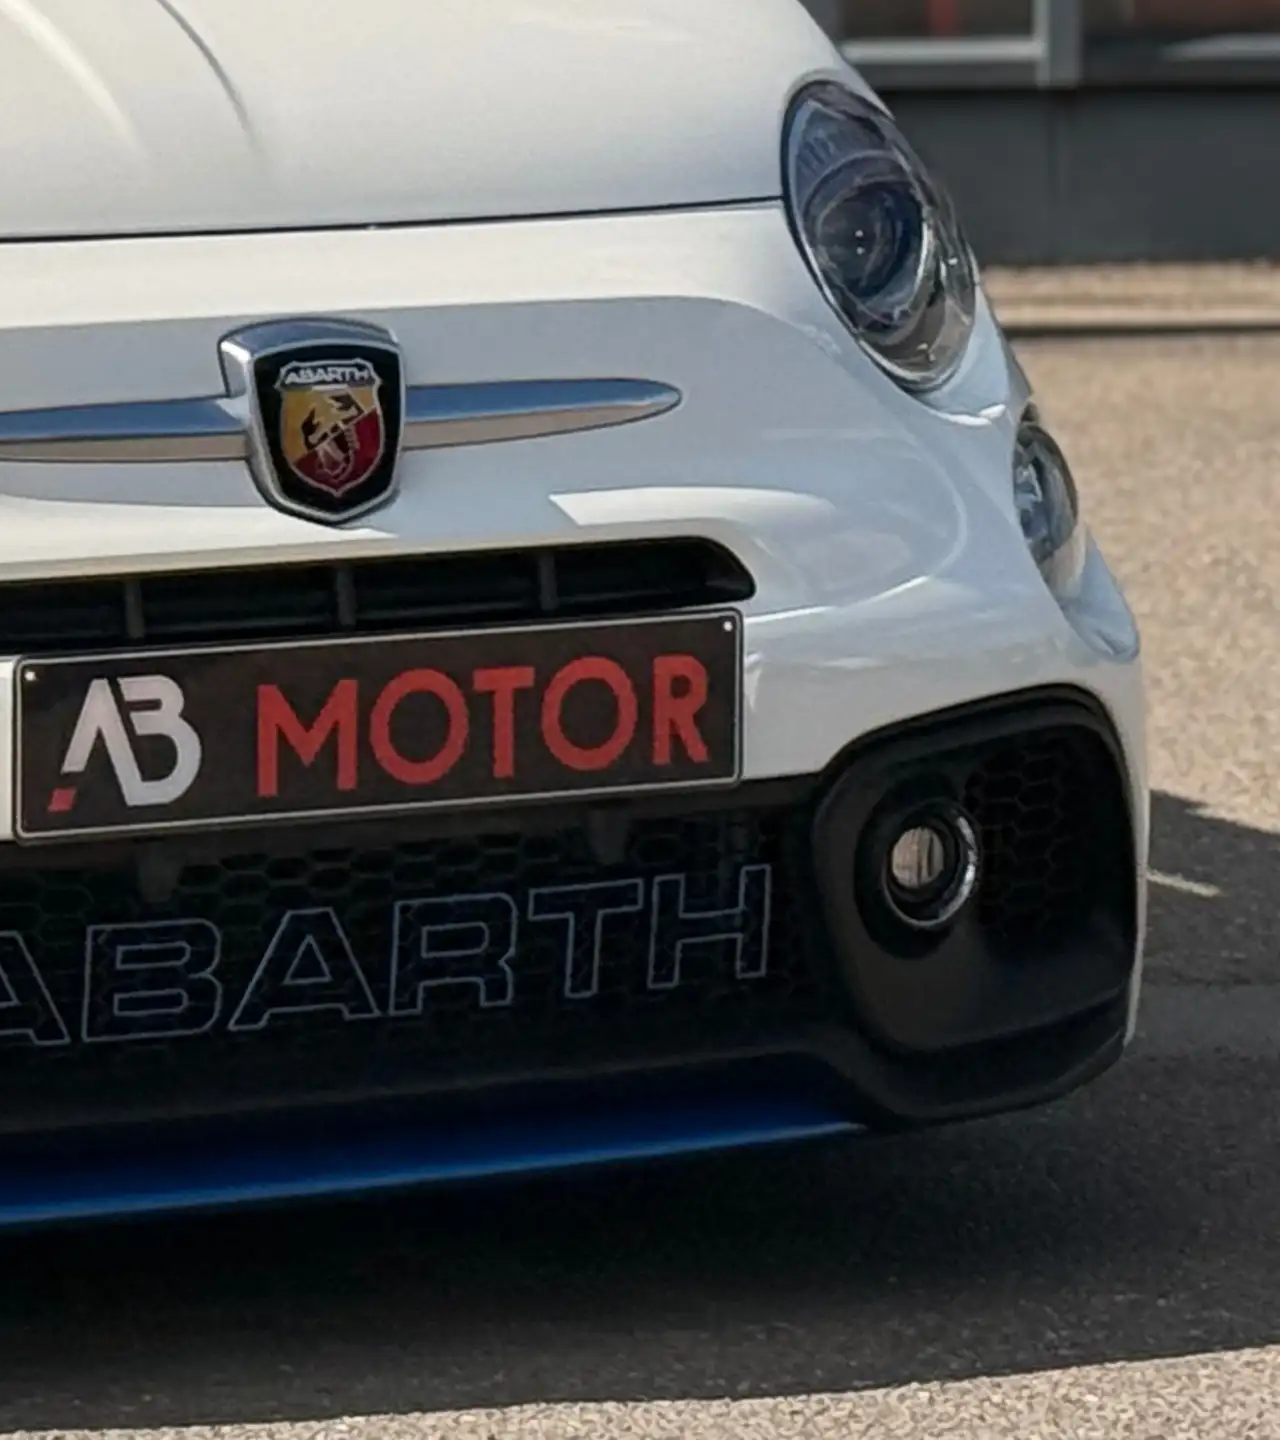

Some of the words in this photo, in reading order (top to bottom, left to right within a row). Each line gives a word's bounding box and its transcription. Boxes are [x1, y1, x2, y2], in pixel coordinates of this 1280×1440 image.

[284, 366, 370, 385] ABARTH
[47, 673, 203, 813] AB
[255, 654, 711, 798] MOTOR
